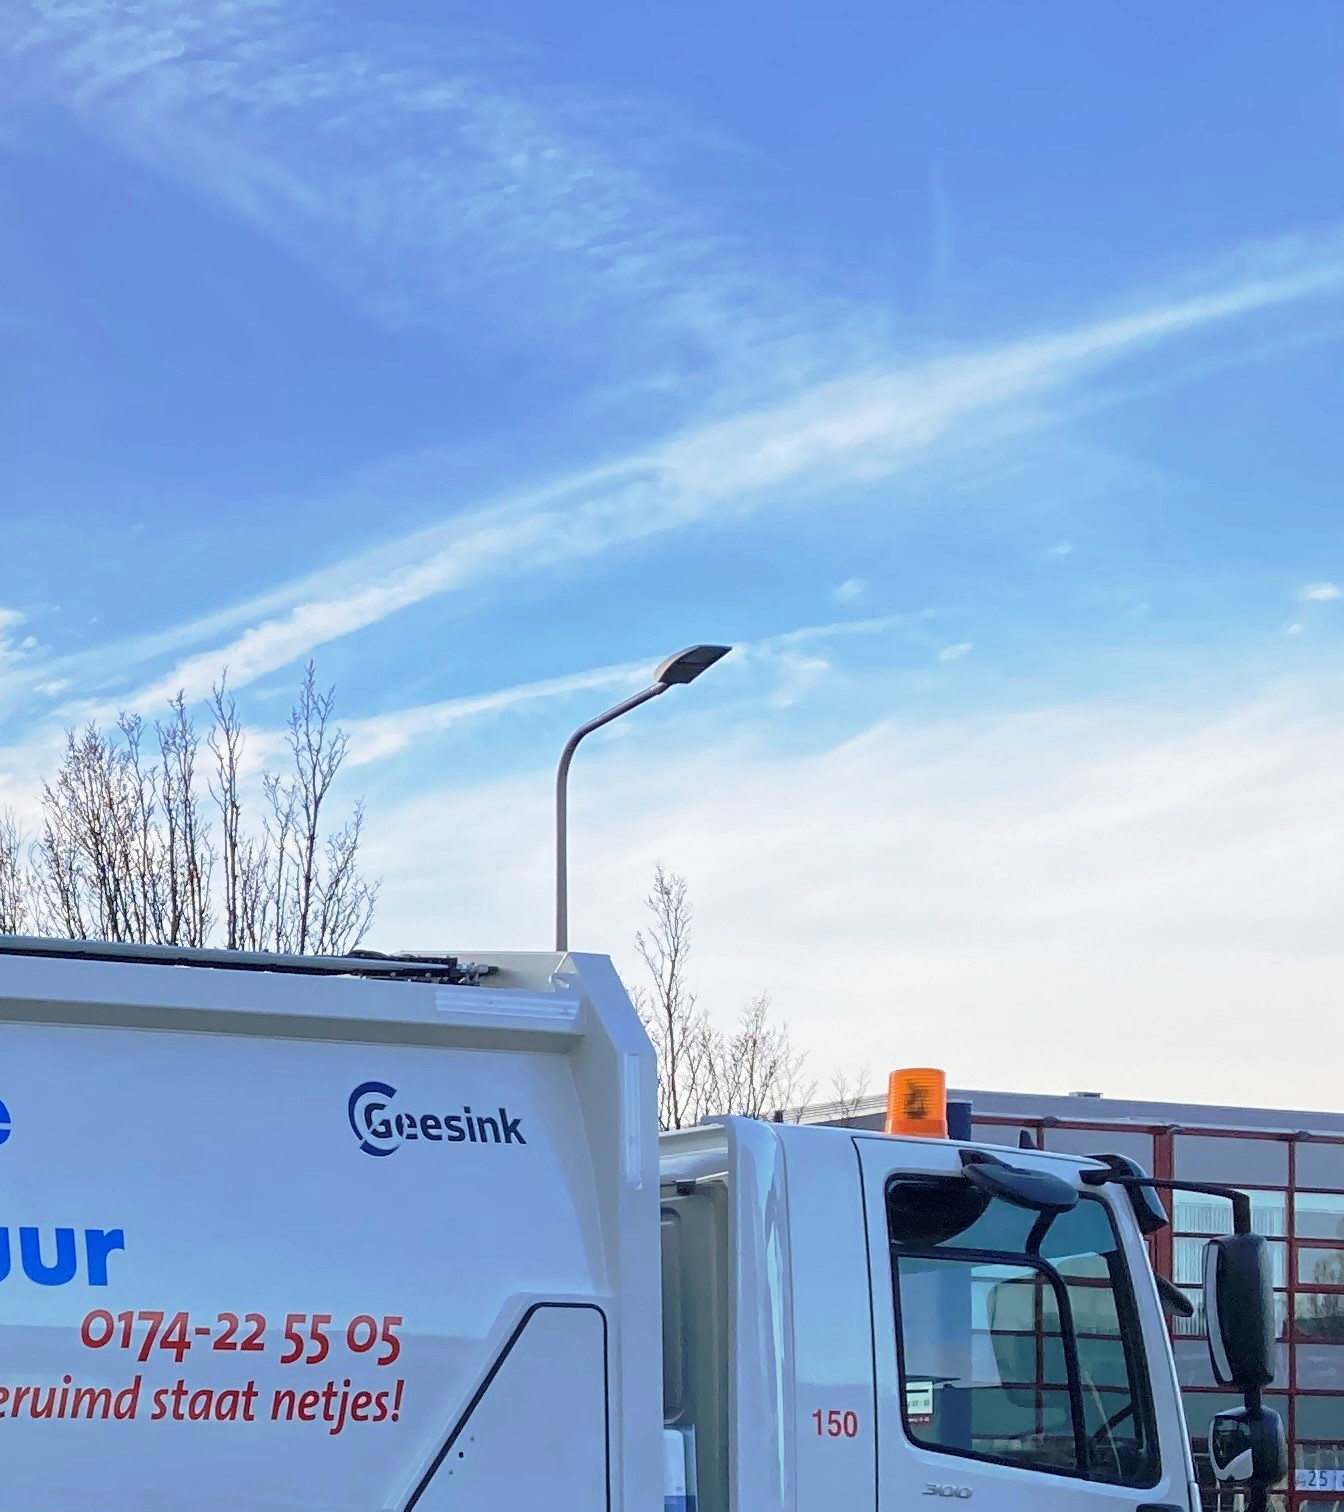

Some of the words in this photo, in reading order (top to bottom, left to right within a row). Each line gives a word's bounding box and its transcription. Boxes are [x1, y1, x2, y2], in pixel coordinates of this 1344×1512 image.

[348, 1081, 528, 1158] Geesink
[80, 1309, 267, 1363] 0174-22
[279, 1313, 332, 1366] 55
[345, 1314, 404, 1366] 05
[150, 1378, 259, 1422] staat
[270, 1378, 406, 1435] netjes!
[812, 1408, 858, 1437] 150
